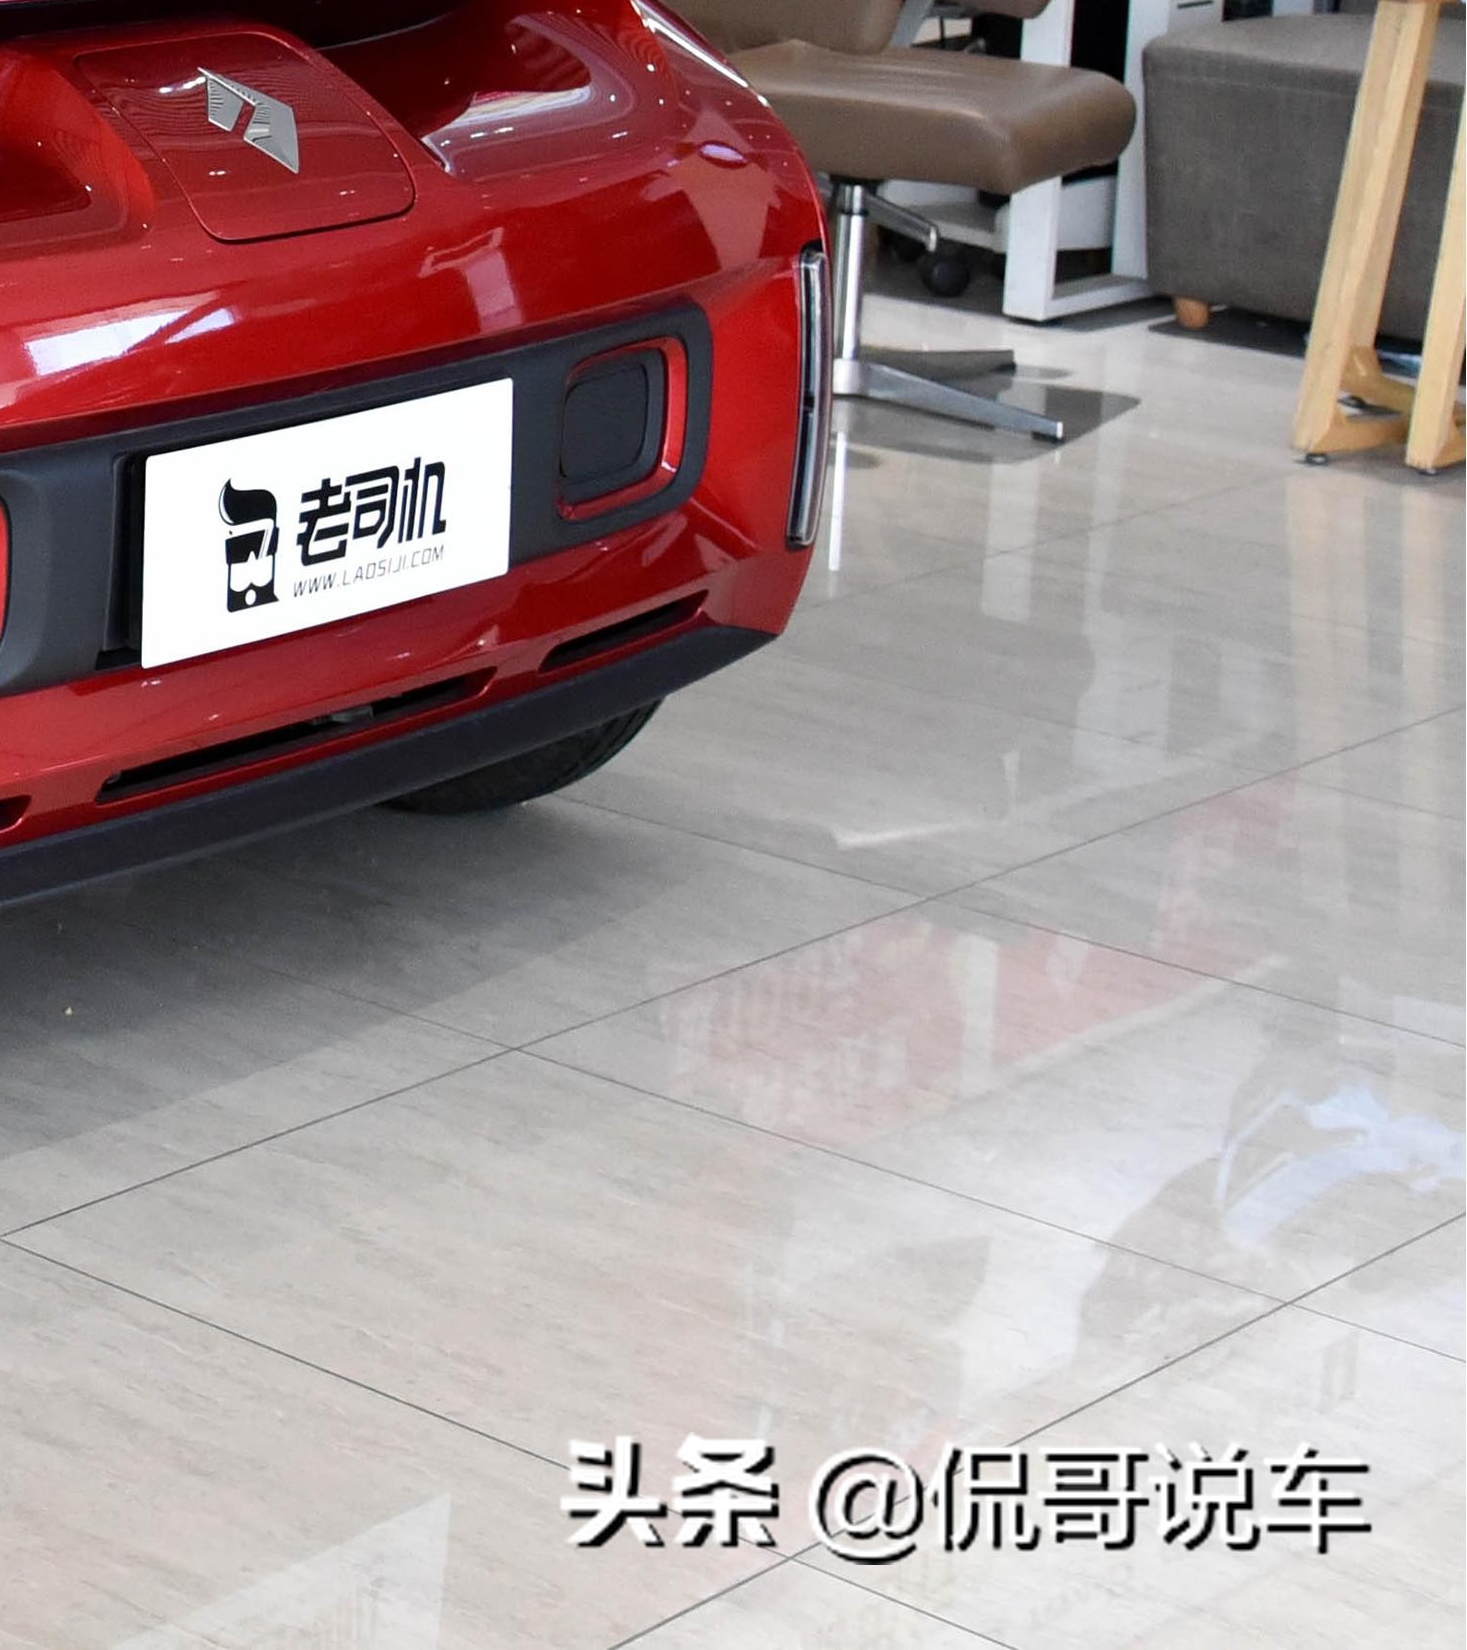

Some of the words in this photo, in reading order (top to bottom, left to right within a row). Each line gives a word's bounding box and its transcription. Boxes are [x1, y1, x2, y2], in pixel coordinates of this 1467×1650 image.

[296, 456, 447, 567] 老司机
[293, 544, 445, 598] WWW.LAOSIJI.COM
